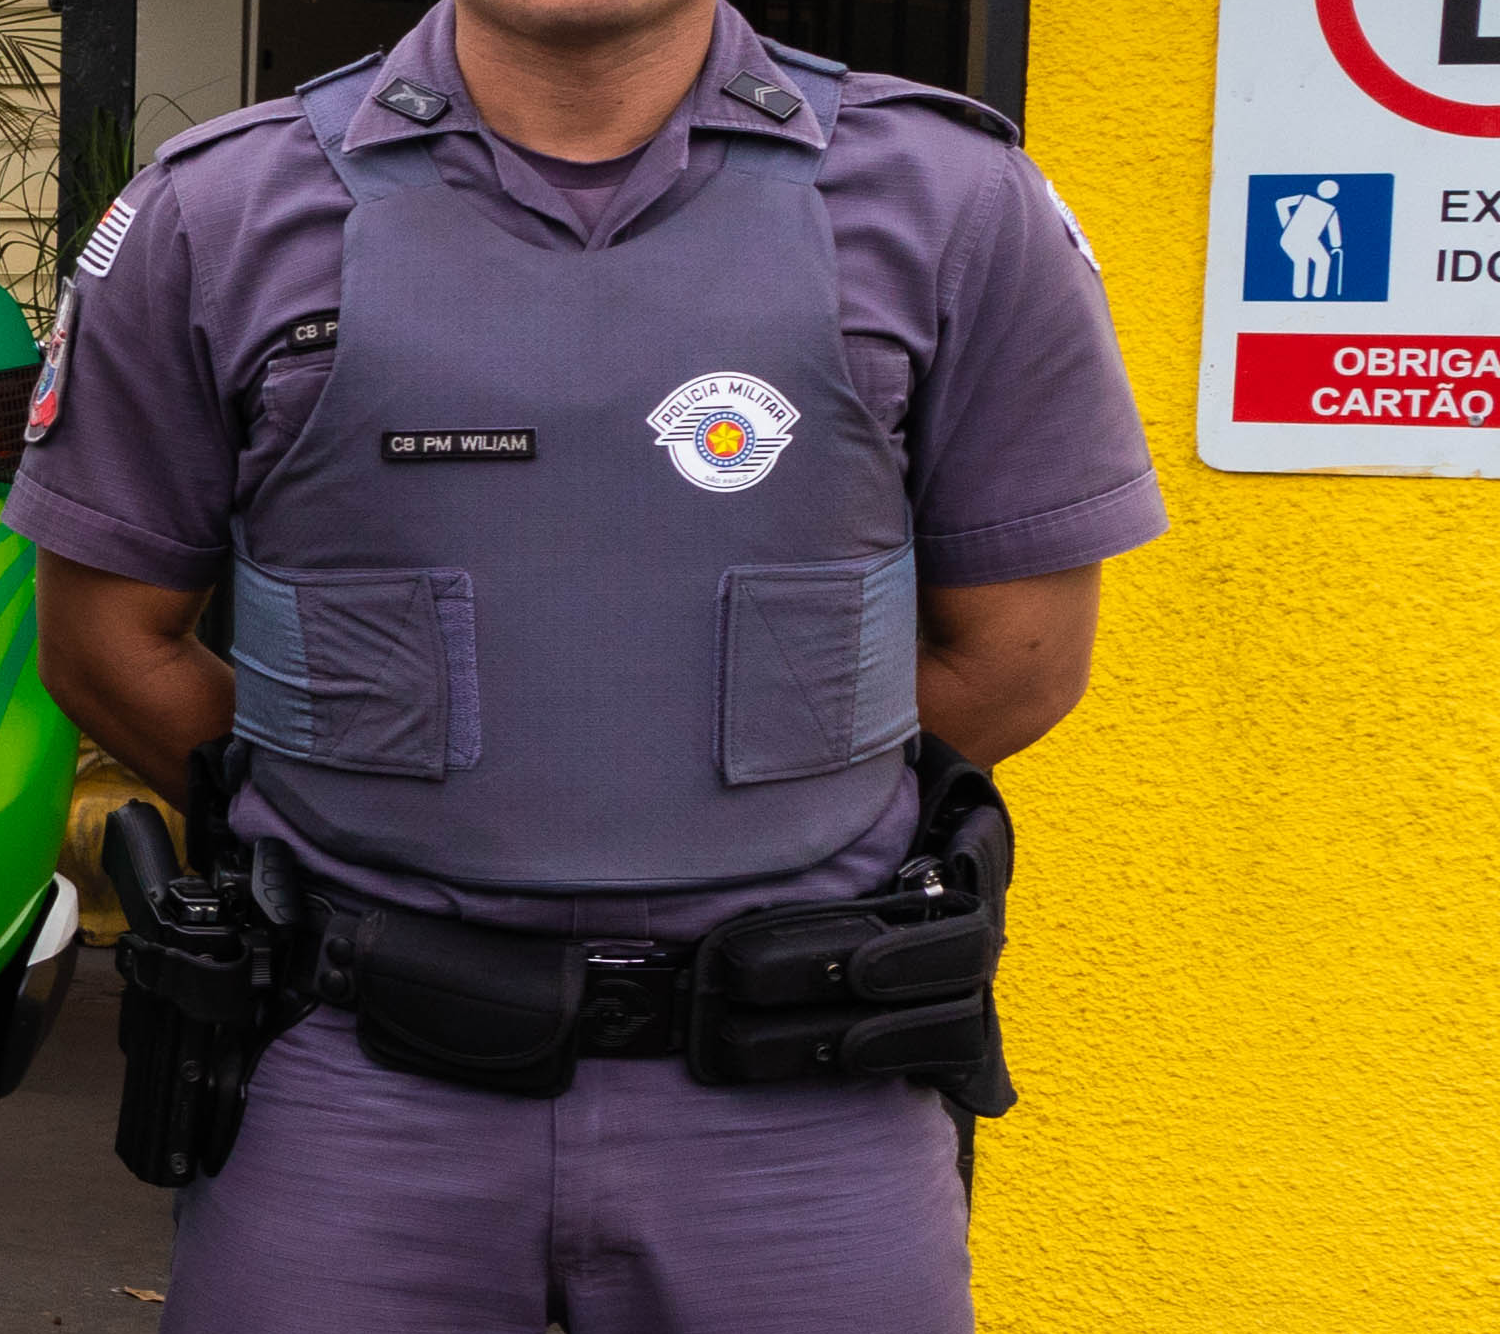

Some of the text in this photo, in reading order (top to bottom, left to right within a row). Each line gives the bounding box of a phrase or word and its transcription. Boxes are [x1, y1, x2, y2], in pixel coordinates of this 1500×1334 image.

[295, 324, 318, 340] CB
[661, 381, 787, 425] POLÍCIA MILITAR
[1311, 383, 1494, 419] CARTÃO
[391, 436, 416, 452] CB
[423, 435, 452, 452] PM
